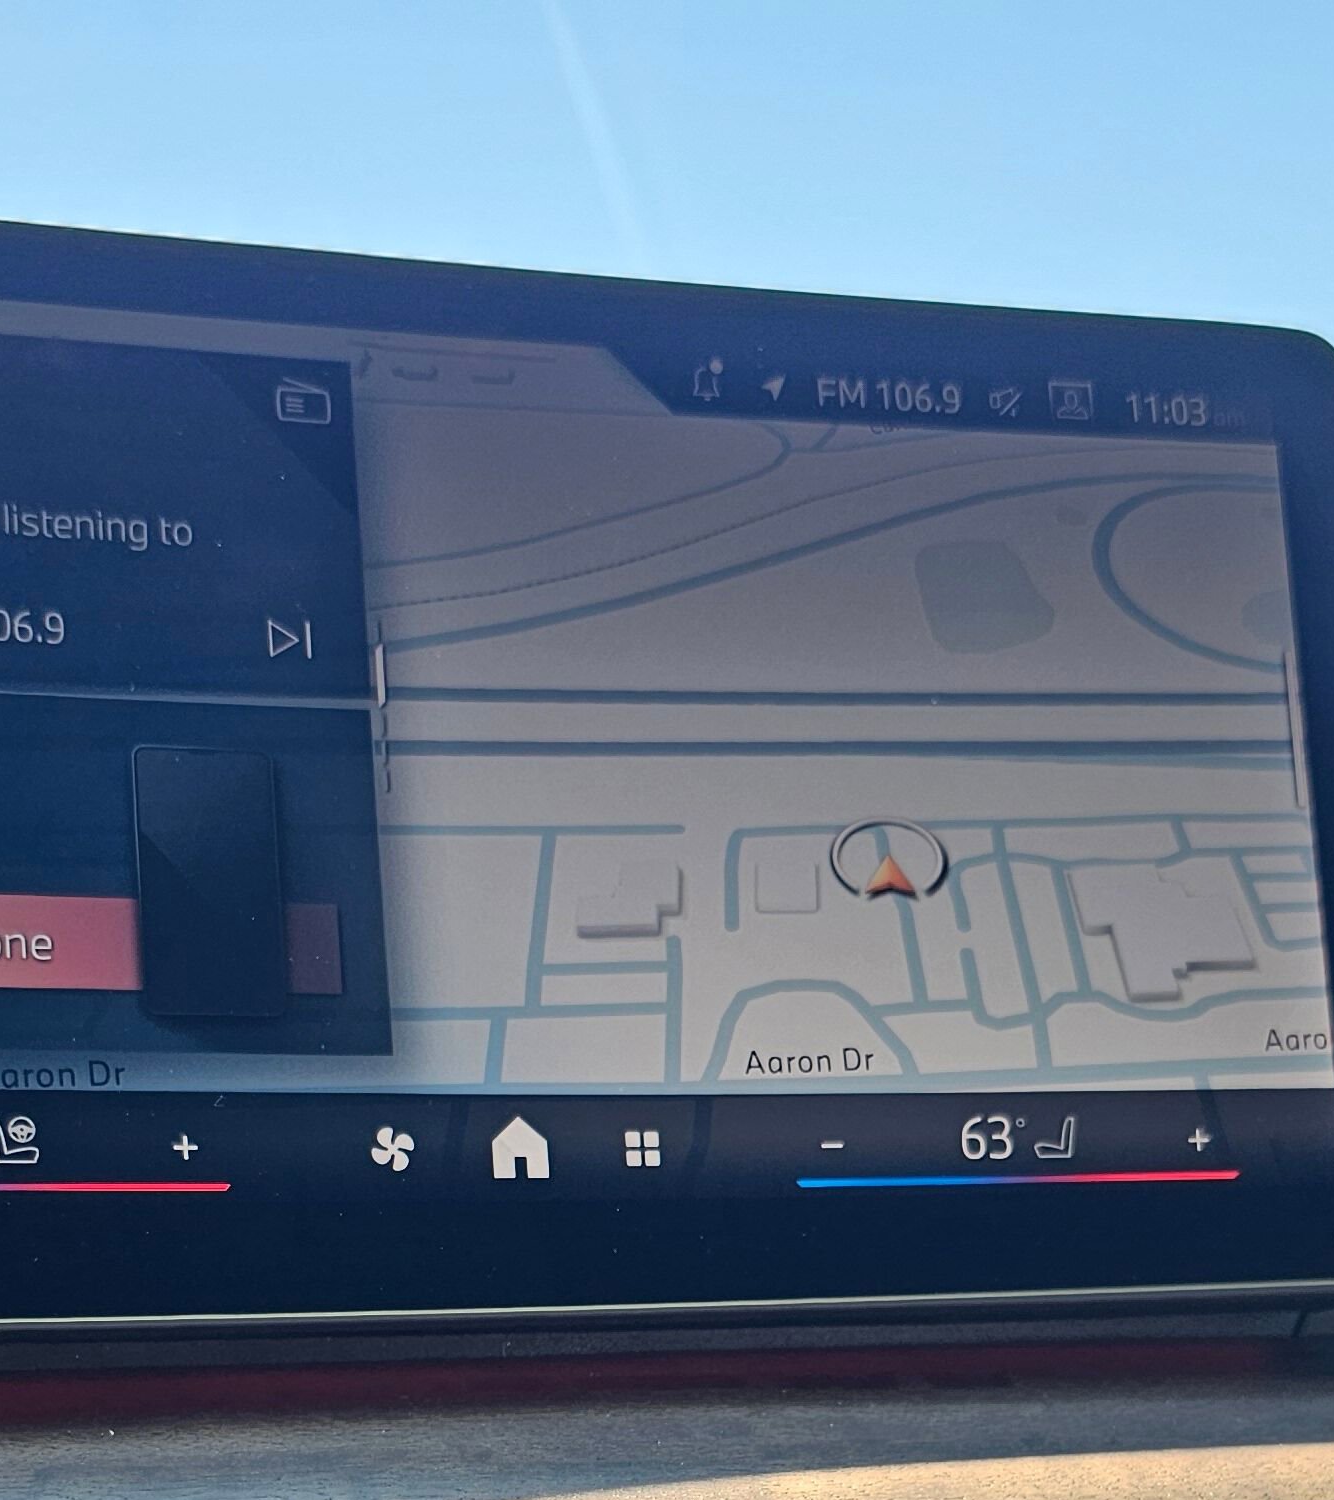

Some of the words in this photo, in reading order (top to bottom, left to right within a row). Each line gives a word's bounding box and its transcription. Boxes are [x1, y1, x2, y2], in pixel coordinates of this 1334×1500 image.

[817, 378, 866, 409] FM
[876, 380, 961, 414] 106.9
[1125, 393, 1206, 427] 11:03
[3, 500, 149, 552] listening
[159, 515, 193, 547] to
[88, 1059, 126, 1088] Dr
[744, 1049, 832, 1076] Aaron
[842, 1047, 875, 1073] Dr
